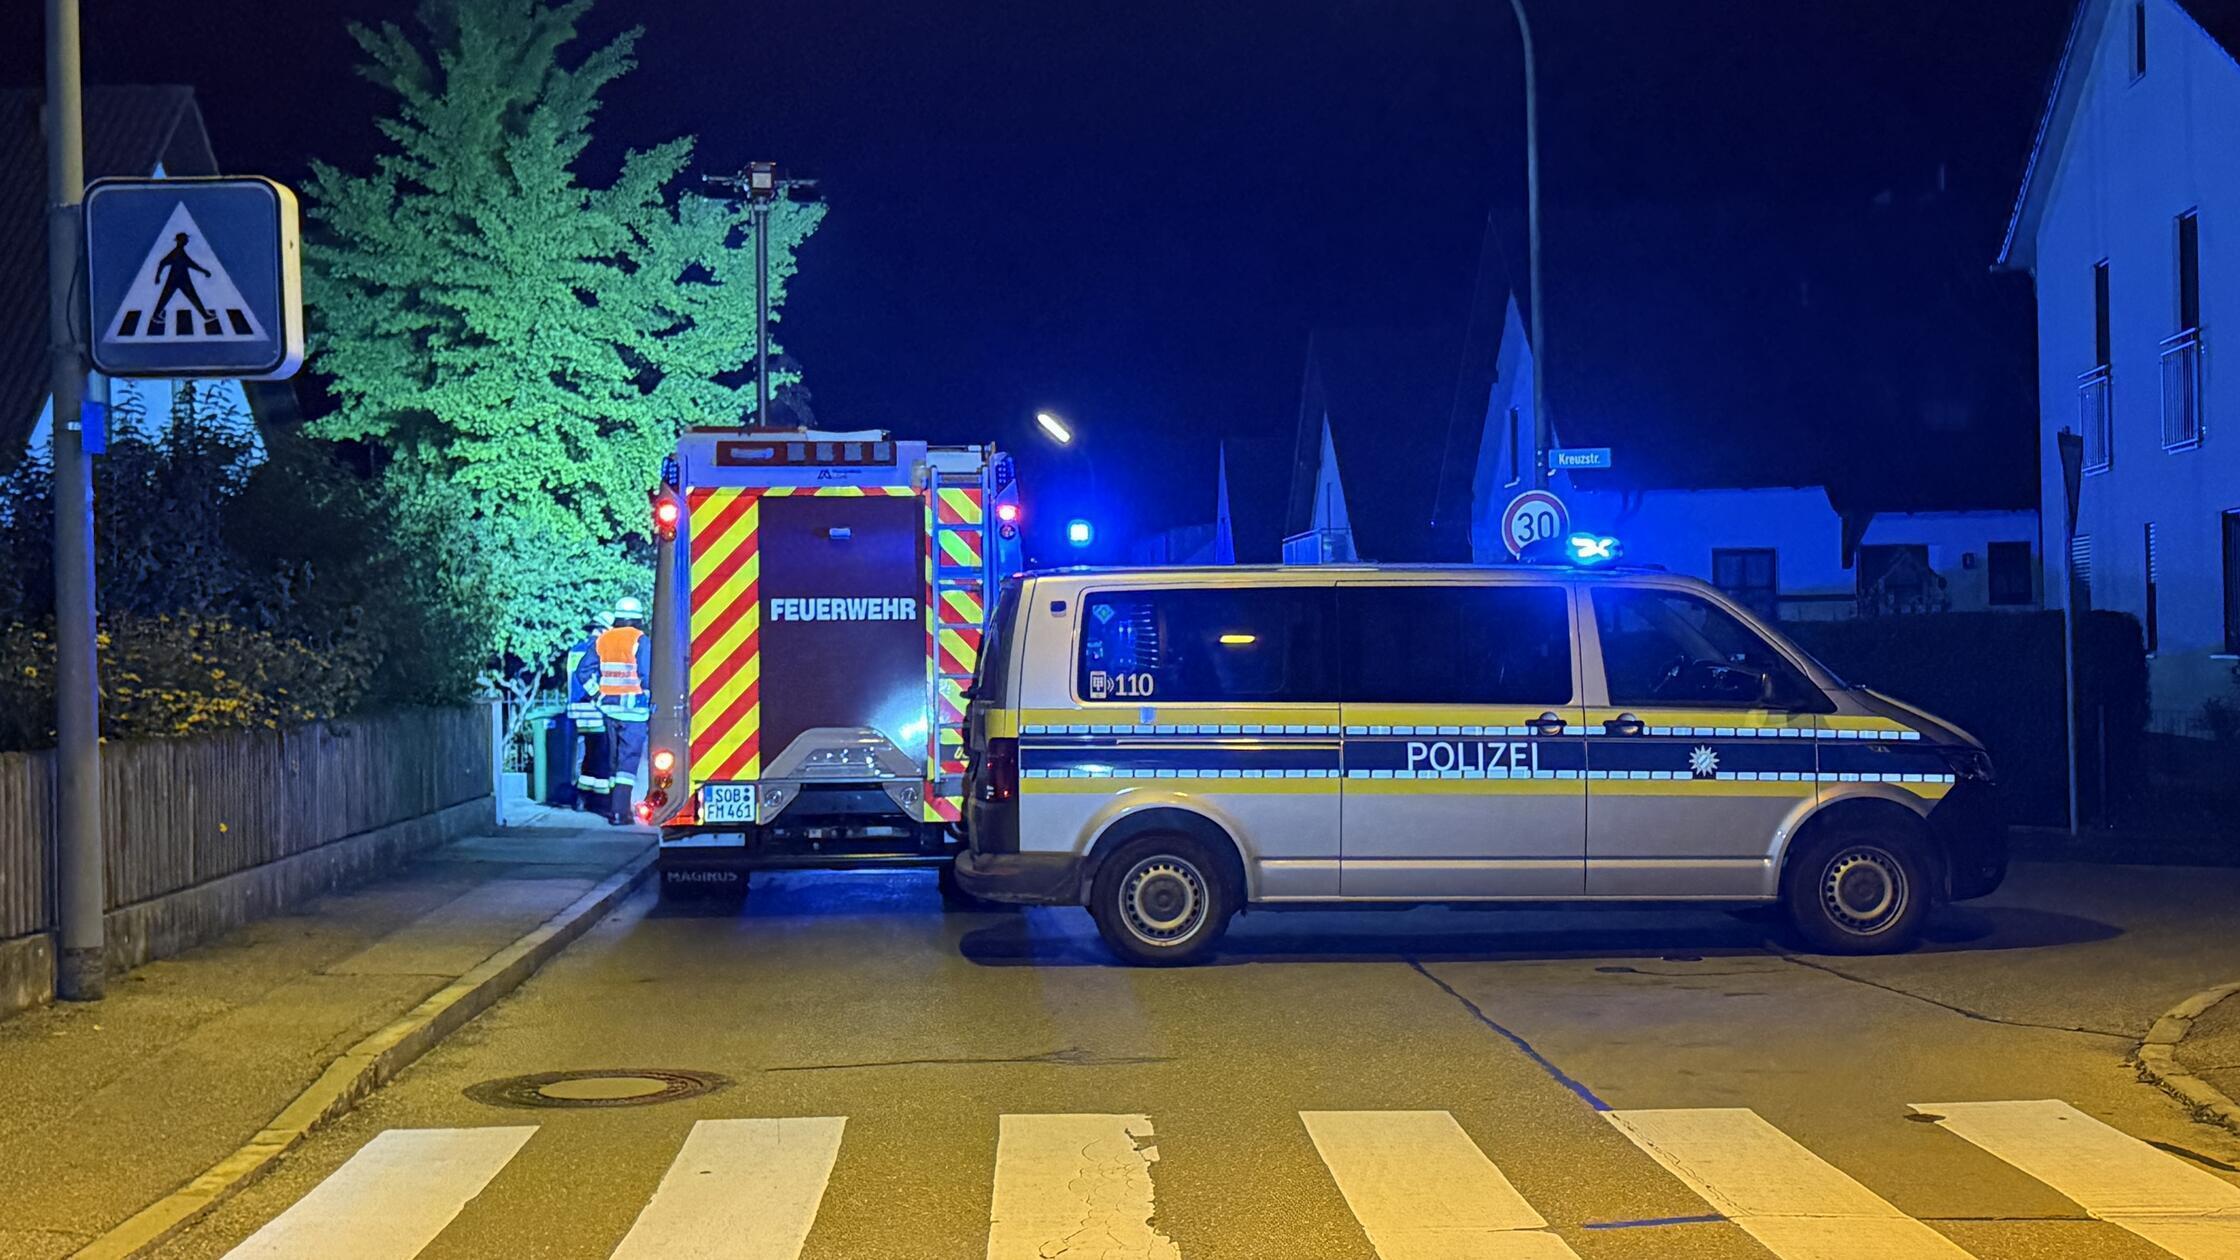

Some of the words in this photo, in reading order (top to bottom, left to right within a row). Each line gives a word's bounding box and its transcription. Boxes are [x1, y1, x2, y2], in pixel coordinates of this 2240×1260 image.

[1558, 452, 1601, 465] Kreuzstr.
[1517, 511, 1554, 542] 30
[770, 598, 917, 621] FEUERWEHR
[1115, 673, 1154, 697] 110
[1407, 741, 1539, 772] POLIZEI
[715, 788, 741, 803] SOB
[727, 802, 751, 819] 461
